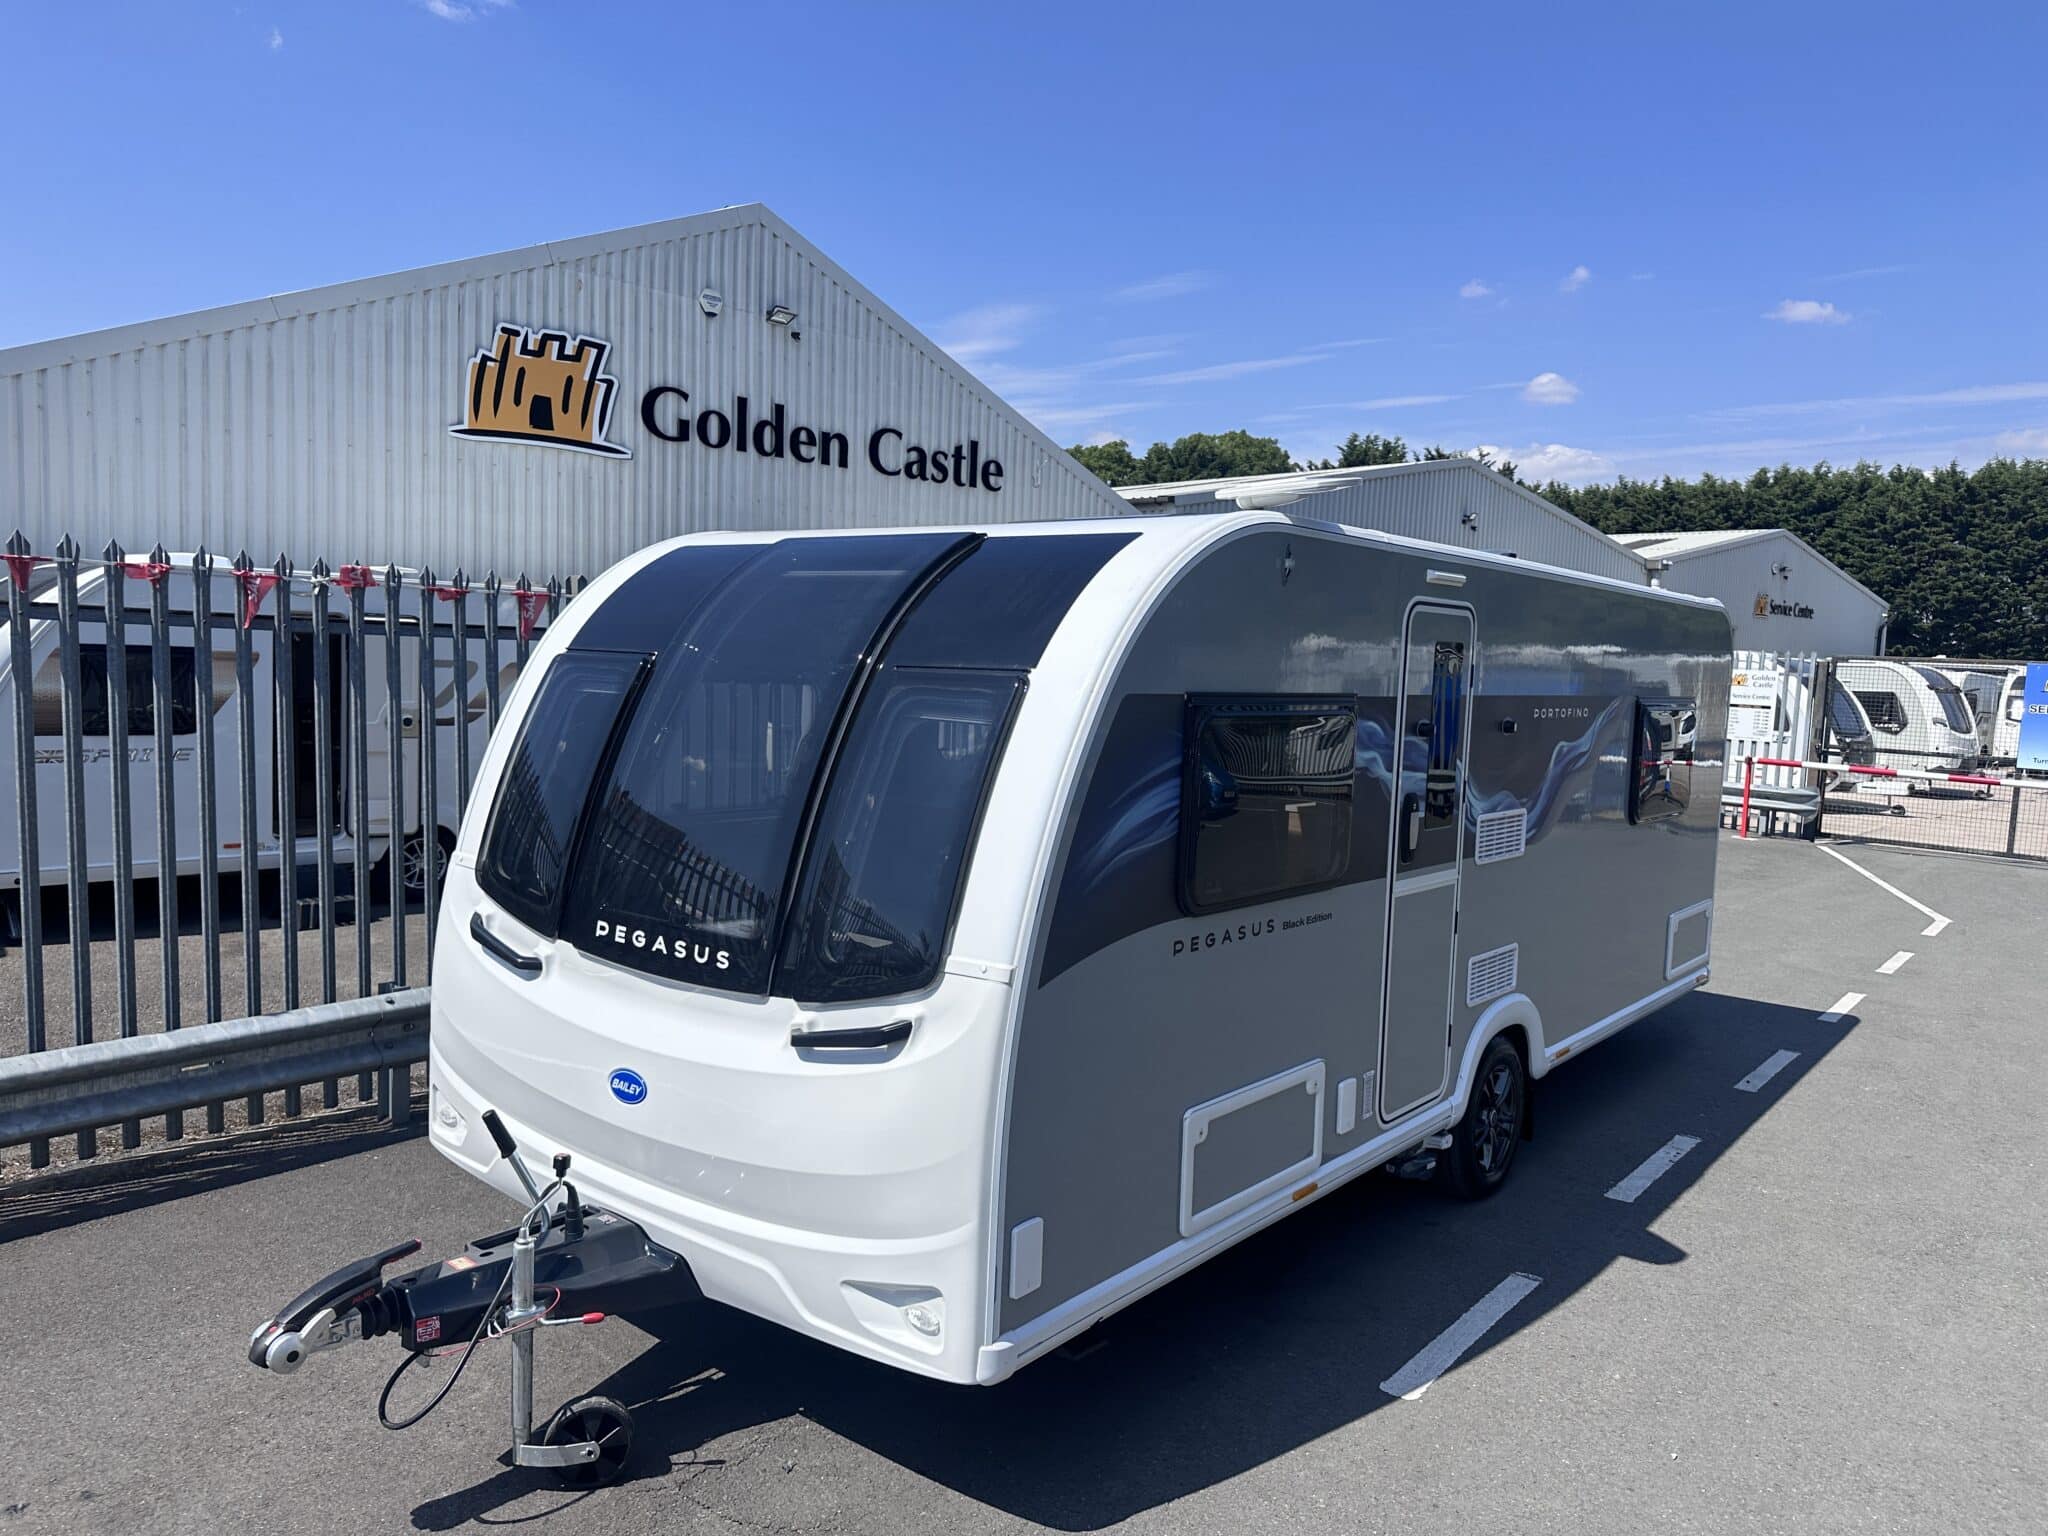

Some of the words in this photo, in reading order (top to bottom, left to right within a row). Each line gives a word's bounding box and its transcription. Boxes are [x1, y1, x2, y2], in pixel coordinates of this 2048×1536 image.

[641, 386, 849, 469] Golden
[868, 427, 1004, 492] Castle
[1769, 599, 1793, 617] Service
[1793, 602, 1814, 619] Centre
[1533, 707, 1589, 719] PORTOFINO
[2030, 704, 2048, 713] SE
[595, 919, 730, 969] PEGASUS
[1173, 919, 1275, 957] PEGASUS
[1282, 918, 1305, 930] Black
[1306, 911, 1333, 925] Edition
[612, 1077, 642, 1096] BAILEY
